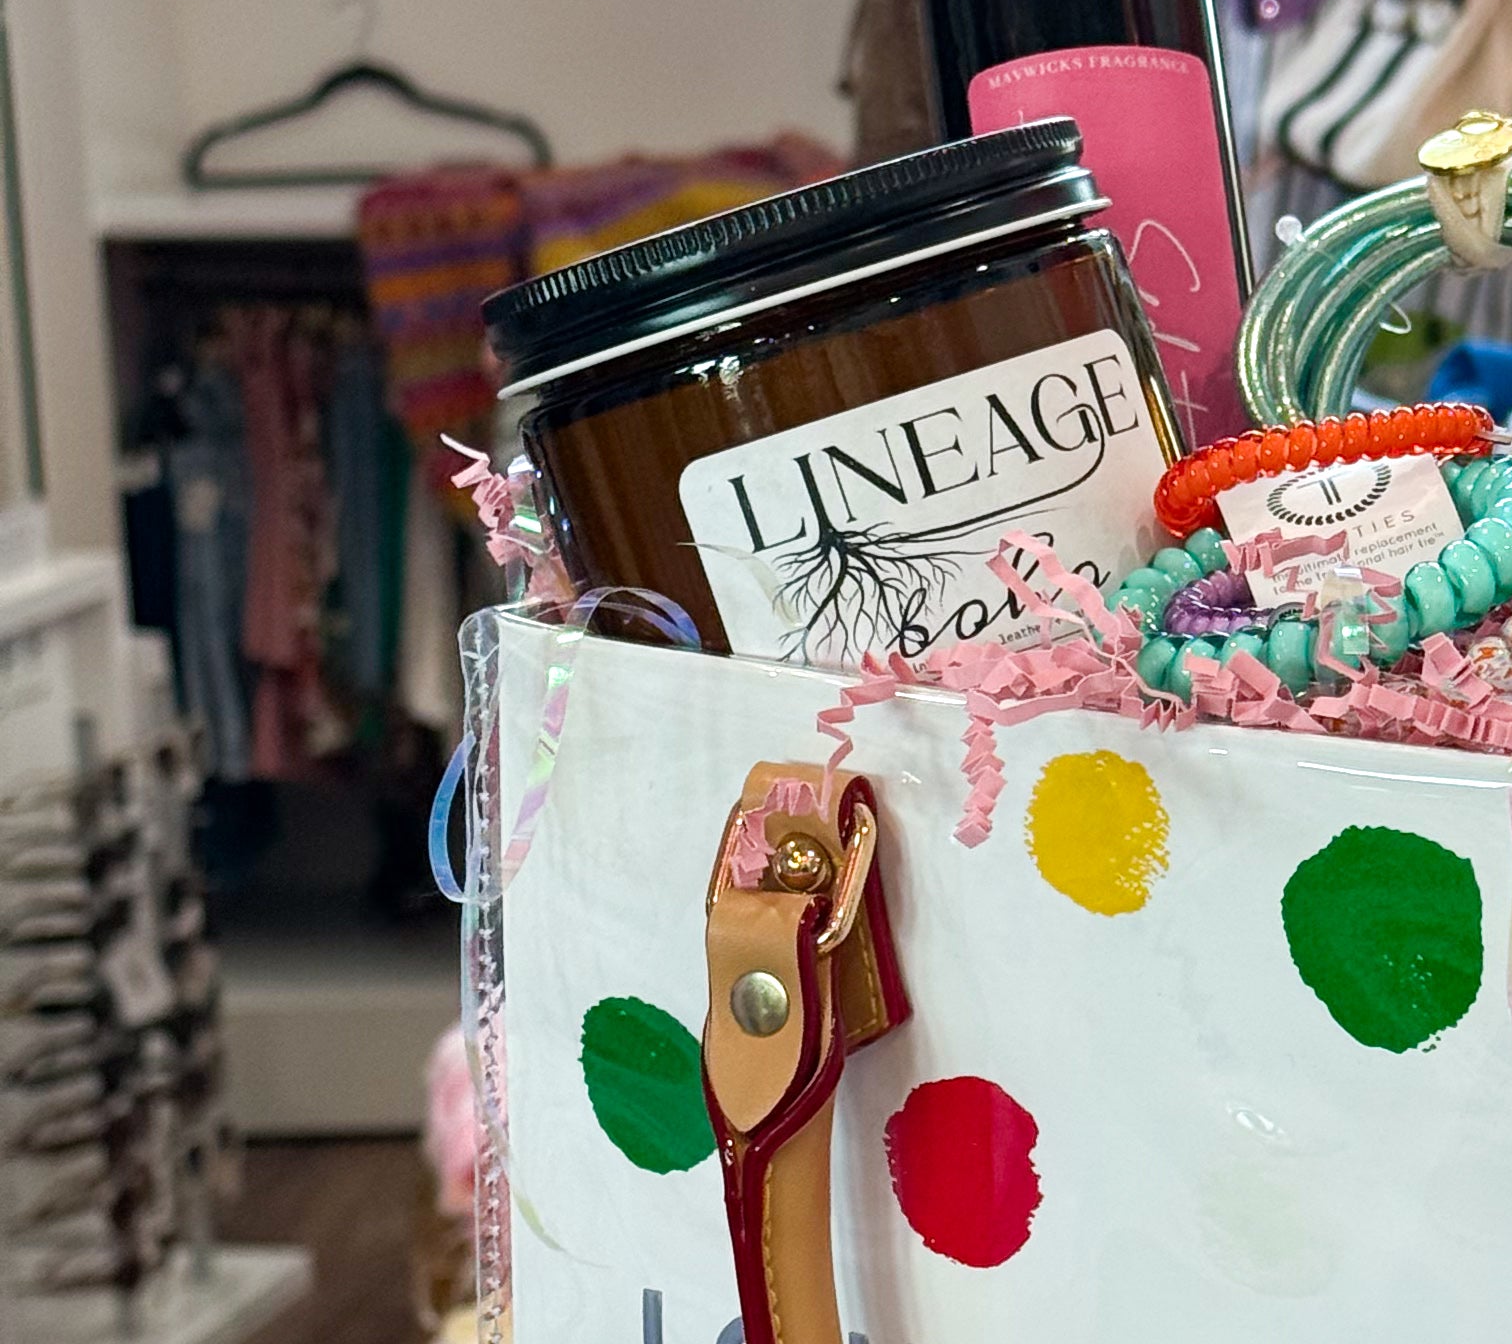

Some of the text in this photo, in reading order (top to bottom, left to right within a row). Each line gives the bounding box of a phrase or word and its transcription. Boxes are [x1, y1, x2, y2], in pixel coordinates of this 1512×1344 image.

[727, 354, 1139, 553] LINEAGE
[1354, 522, 1438, 556] replacement
[1389, 542, 1414, 561] hair
[999, 623, 1042, 645] leathe
